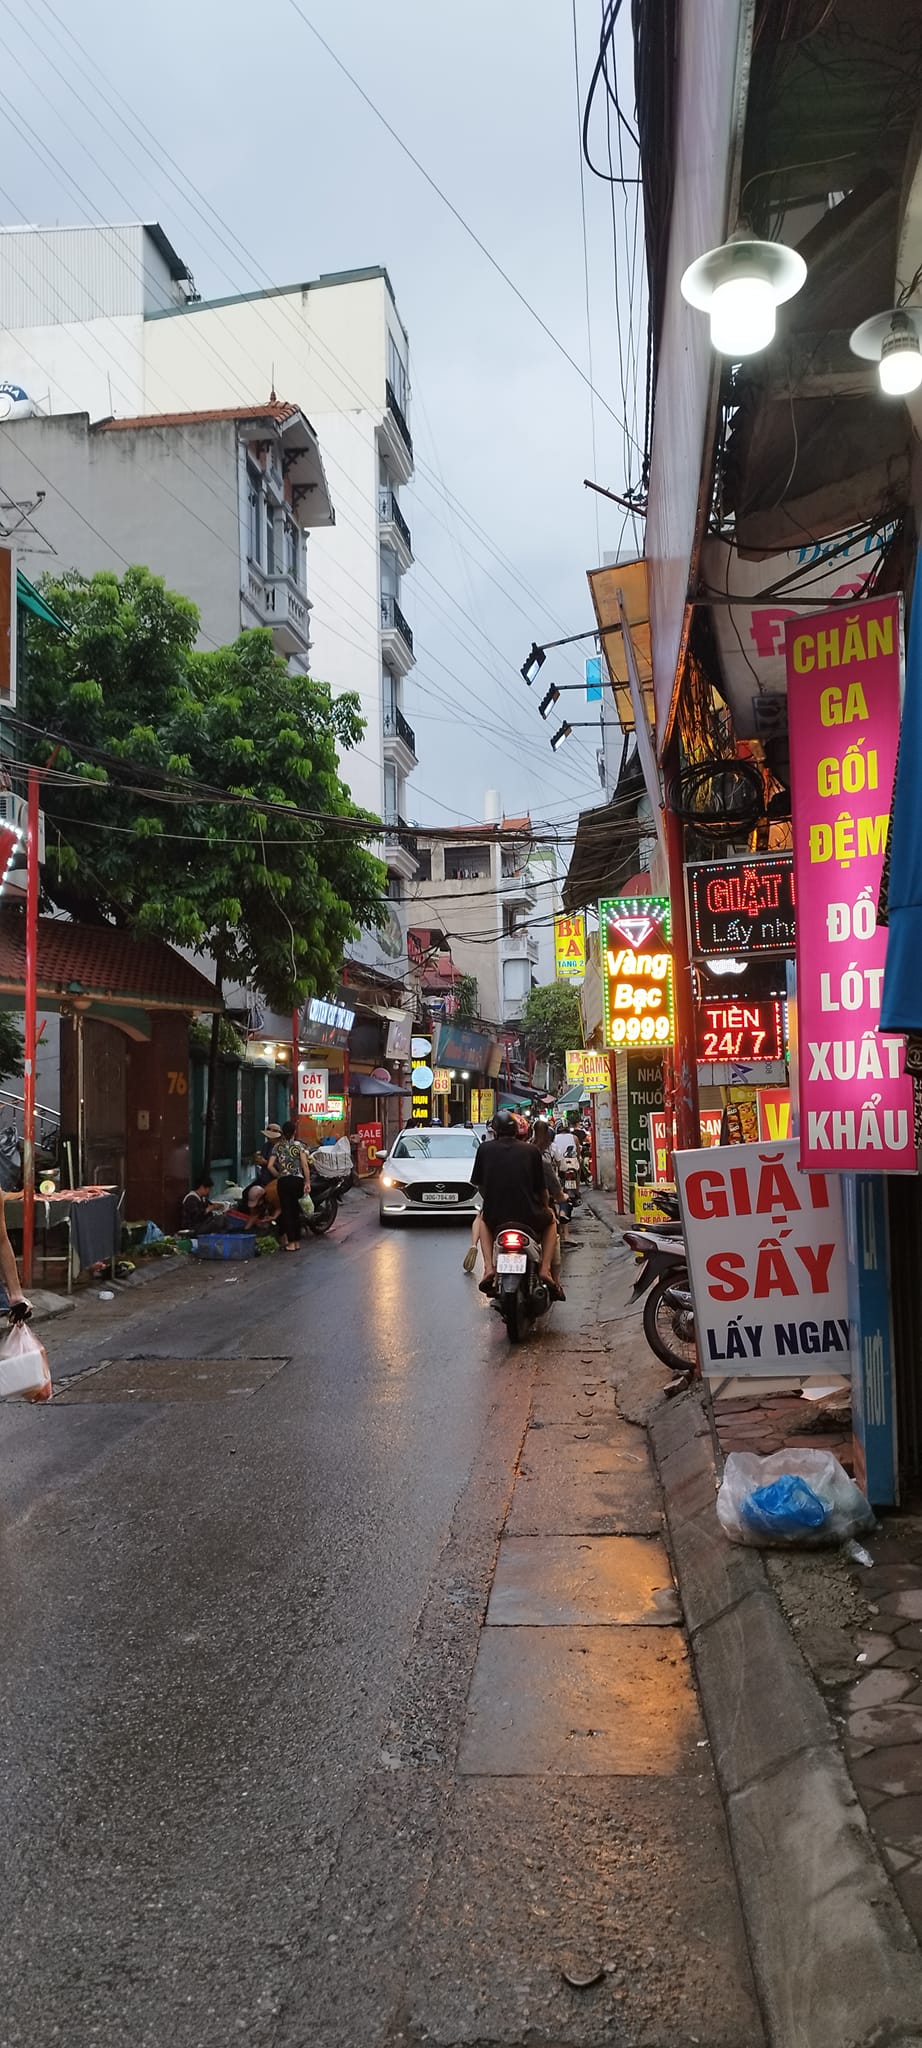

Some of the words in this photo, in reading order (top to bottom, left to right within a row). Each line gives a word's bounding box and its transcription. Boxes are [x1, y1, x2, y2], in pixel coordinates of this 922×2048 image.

[793, 615, 894, 673] CHĂN
[820, 682, 869, 727] GA
[817, 738, 878, 798] GỐI
[809, 812, 889, 868] ĐỆM
[707, 869, 781, 916] GIẶT
[558, 919, 581, 937] BI
[713, 919, 753, 944] Lấy
[827, 886, 876, 943] ĐỒ
[607, 949, 669, 980] Vàng
[614, 983, 662, 1014] Bạc
[820, 962, 884, 1012] LÓT
[611, 1016, 669, 1041] 9999
[583, 1056, 608, 1074] GAME
[808, 1025, 904, 1081] XUẤT
[168, 1072, 187, 1095] 76
[302, 1087, 322, 1099] TÓC
[434, 1080, 448, 1089] 68
[630, 1086, 663, 1105] THUỐ
[300, 1102, 325, 1113] NAM
[808, 1093, 907, 1151] KHẨU
[358, 1129, 381, 1138] SALE
[684, 1152, 830, 1224] GIẶT
[706, 1229, 835, 1302] SẤY
[707, 1315, 763, 1360] LẤY
[774, 1318, 853, 1356] NGAY
